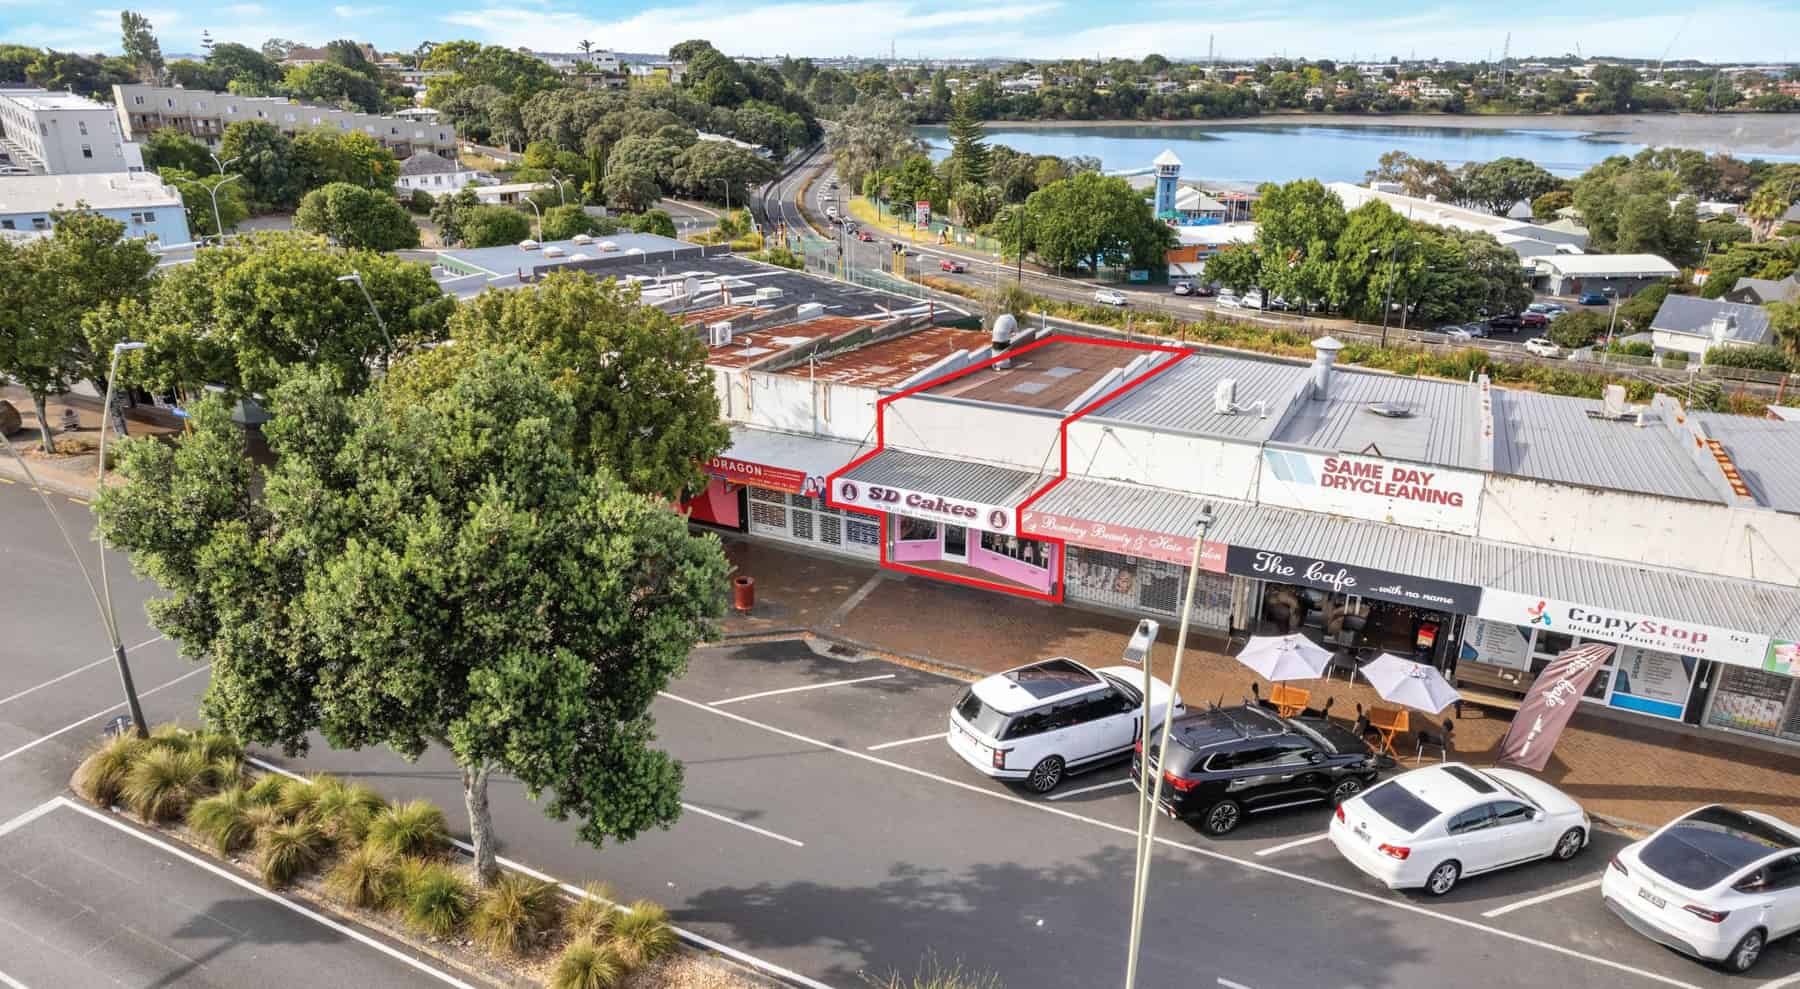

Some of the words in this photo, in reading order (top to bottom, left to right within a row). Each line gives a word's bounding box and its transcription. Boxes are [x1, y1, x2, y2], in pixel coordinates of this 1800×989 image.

[712, 458, 763, 476] DRAGON
[1323, 457, 1384, 480] SAME
[1391, 467, 1435, 487] DAY
[868, 486, 901, 501] SD
[905, 493, 978, 519] Cakes
[1320, 473, 1464, 508] DRYCLEANING
[1042, 516, 1087, 537] Bombay
[1092, 525, 1131, 546] Beauty
[1149, 535, 1184, 553] Hair
[1252, 551, 1296, 577] The
[1302, 560, 1358, 592] Cafe
[1405, 590, 1420, 600] no
[1422, 593, 1455, 605] name
[1568, 607, 1709, 644] CopyStop
